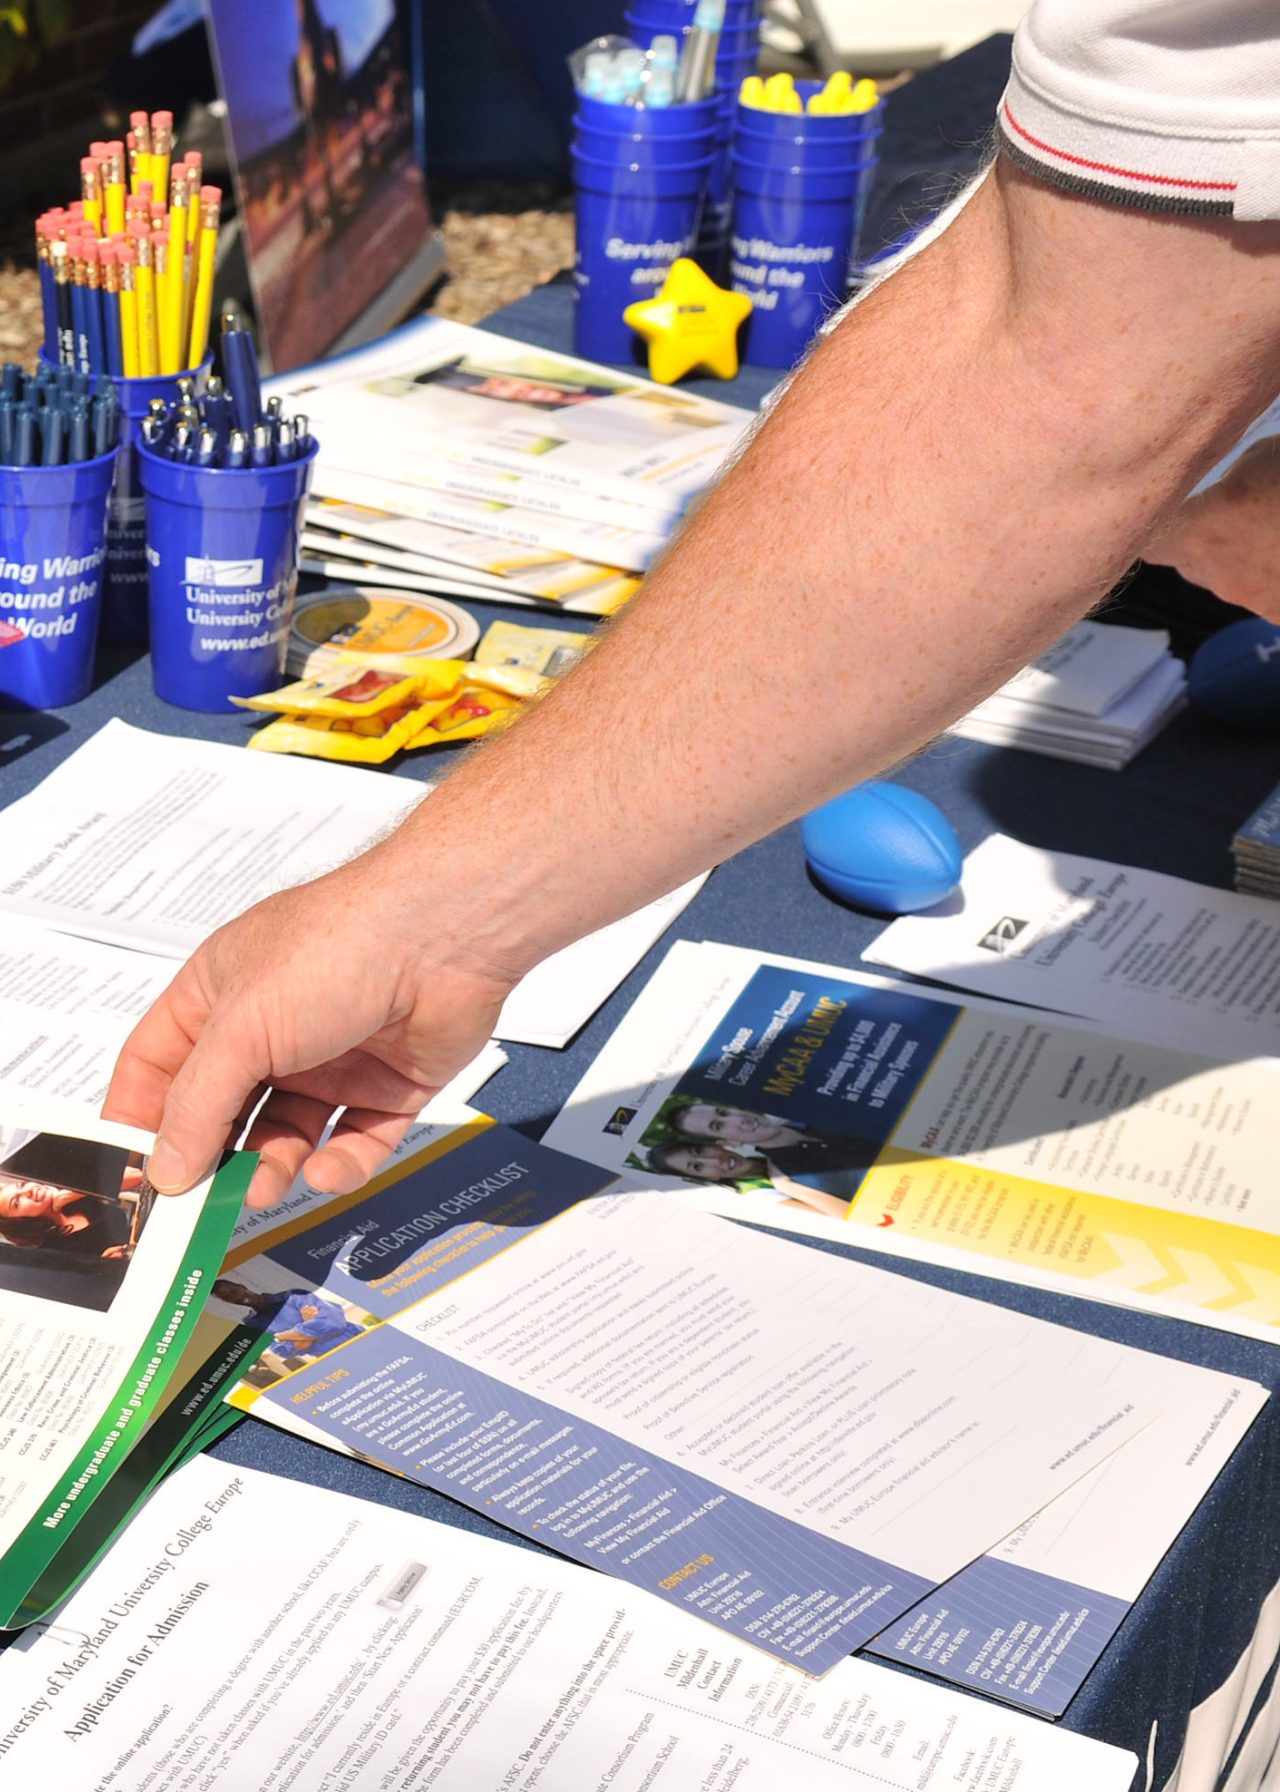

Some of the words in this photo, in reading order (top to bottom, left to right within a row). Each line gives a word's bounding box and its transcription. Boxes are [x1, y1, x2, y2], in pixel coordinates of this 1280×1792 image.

[68, 580, 98, 605] the
[185, 586, 265, 606] University
[266, 581, 281, 600] of
[8, 612, 78, 640] World
[186, 606, 264, 628] University
[802, 996, 849, 1036] UMUC
[846, 1059, 879, 1094] Financial
[334, 1210, 448, 1277] APPLICATION
[438, 1160, 531, 1216] CHECKLIST
[307, 1231, 360, 1260] Financial
[356, 1219, 381, 1239] Aid
[42, 1502, 71, 1529] More
[65, 1430, 120, 1501] undergraduate
[115, 1408, 134, 1429] and
[128, 1357, 162, 1407] graduate
[156, 1309, 185, 1354] classes
[175, 1269, 203, 1307] inside
[204, 1477, 243, 1515] Europe
[164, 1515, 213, 1557] College
[108, 1558, 176, 1617] University
[53, 1617, 119, 1681] Maryland
[63, 1668, 137, 1743] Application
[126, 1644, 154, 1667] for
[146, 1582, 210, 1647] Admission
[46, 1676, 65, 1696] of
[697, 1660, 723, 1691] Contact
[707, 1656, 745, 1703] Information
[517, 1749, 532, 1763] Do
[529, 1735, 544, 1752] not
[537, 1716, 557, 1739] enter
[551, 1682, 579, 1719] anything
[571, 1671, 589, 1687] into
[582, 1656, 597, 1672] the
[591, 1635, 610, 1659] space
